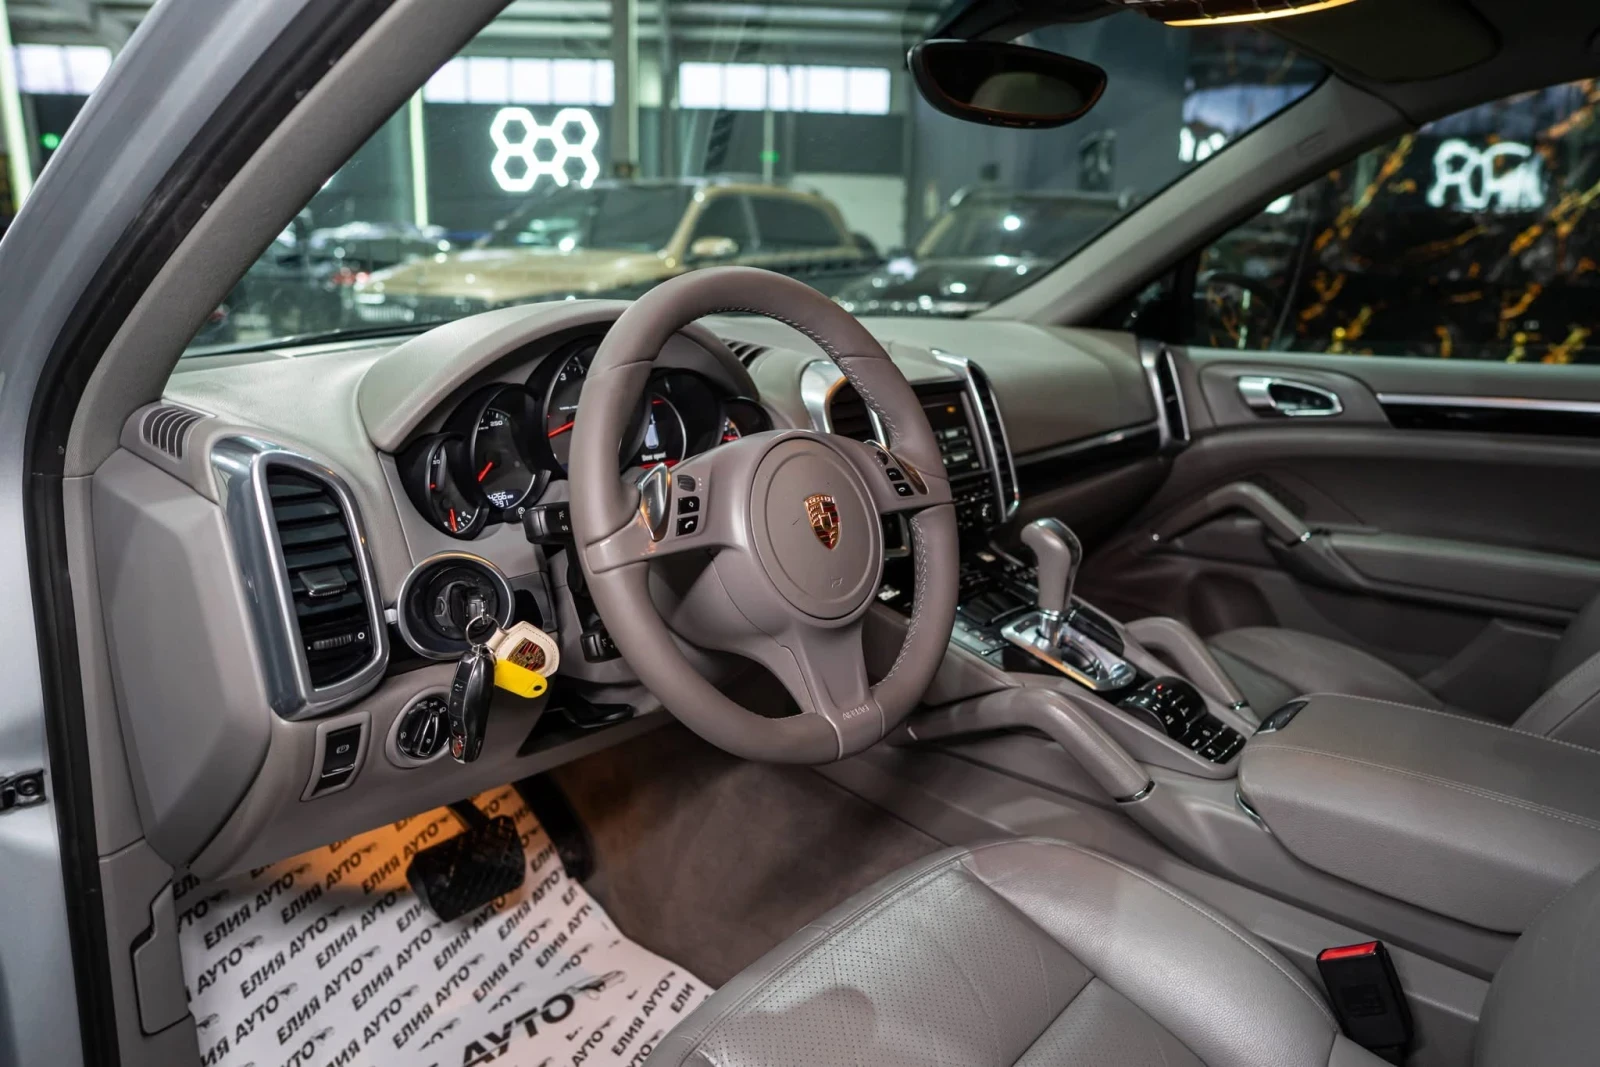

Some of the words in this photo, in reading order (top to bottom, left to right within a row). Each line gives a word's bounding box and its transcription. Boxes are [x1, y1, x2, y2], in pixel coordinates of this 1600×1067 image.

[560, 372, 567, 381] 3
[281, 883, 323, 925] ЕЛИЯ
[326, 852, 362, 891] АУТО
[361, 854, 401, 895] ЕЛИЯ
[403, 823, 439, 860] АУТО
[204, 904, 251, 950] ЕЛИЯ
[255, 872, 294, 913] АУТО
[315, 924, 357, 970] ЕЛИЯ
[361, 891, 397, 931] АУТО
[498, 901, 532, 941] ЕЛИЯ
[532, 869, 561, 905] АУТО
[535, 932, 569, 968] ЕЛИЯ
[567, 904, 593, 934] АУТ
[198, 947, 243, 996] АУТО
[239, 949, 286, 999] ЕЛИЯ
[290, 917, 328, 958] АУТО
[352, 964, 394, 1012] ЕЛИЯ
[396, 928, 432, 969] АУТО
[433, 927, 472, 971] ЕЛИЯ
[472, 963, 509, 1003] ЕЛИЯ
[508, 929, 540, 967] АУТО
[236, 995, 279, 1045] АУТО
[276, 995, 321, 1045] ЕЛИЯ
[324, 958, 363, 1003] АУТО
[363, 997, 402, 1045] АУТО
[392, 1002, 434, 1050] ЕЛИЯ
[435, 965, 470, 1007] АУТО
[463, 993, 576, 1067] АУТО
[611, 1016, 646, 1057] ЕЛИЯ
[642, 979, 671, 1018] АУТО
[571, 1030, 604, 1067] АУТО
